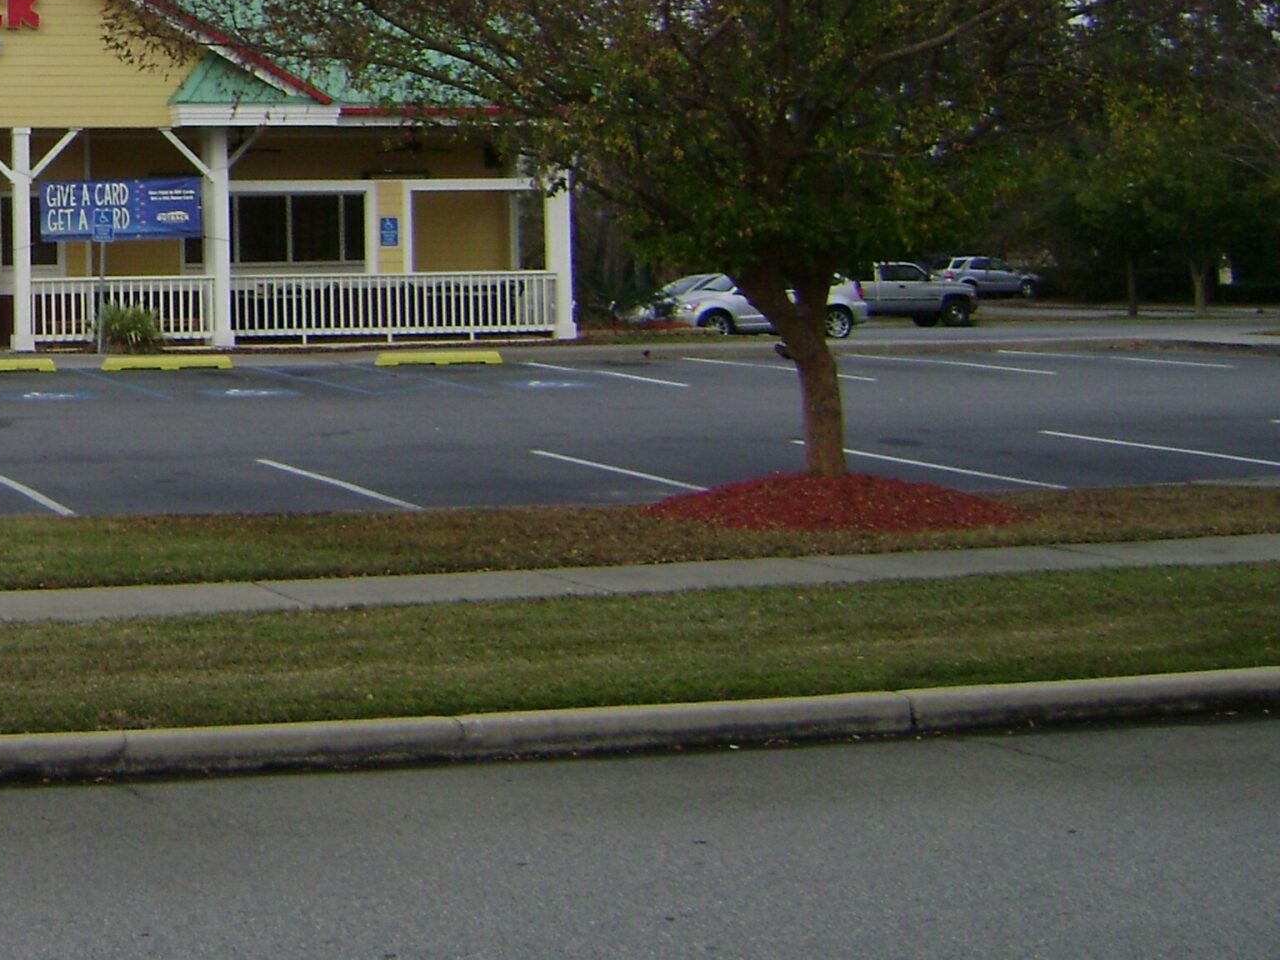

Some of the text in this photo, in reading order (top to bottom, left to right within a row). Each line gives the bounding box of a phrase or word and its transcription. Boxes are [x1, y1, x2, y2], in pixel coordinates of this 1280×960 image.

[82, 183, 90, 206] A
[94, 183, 128, 205] CARD
[47, 209, 74, 231] GET
[79, 208, 89, 230] A
